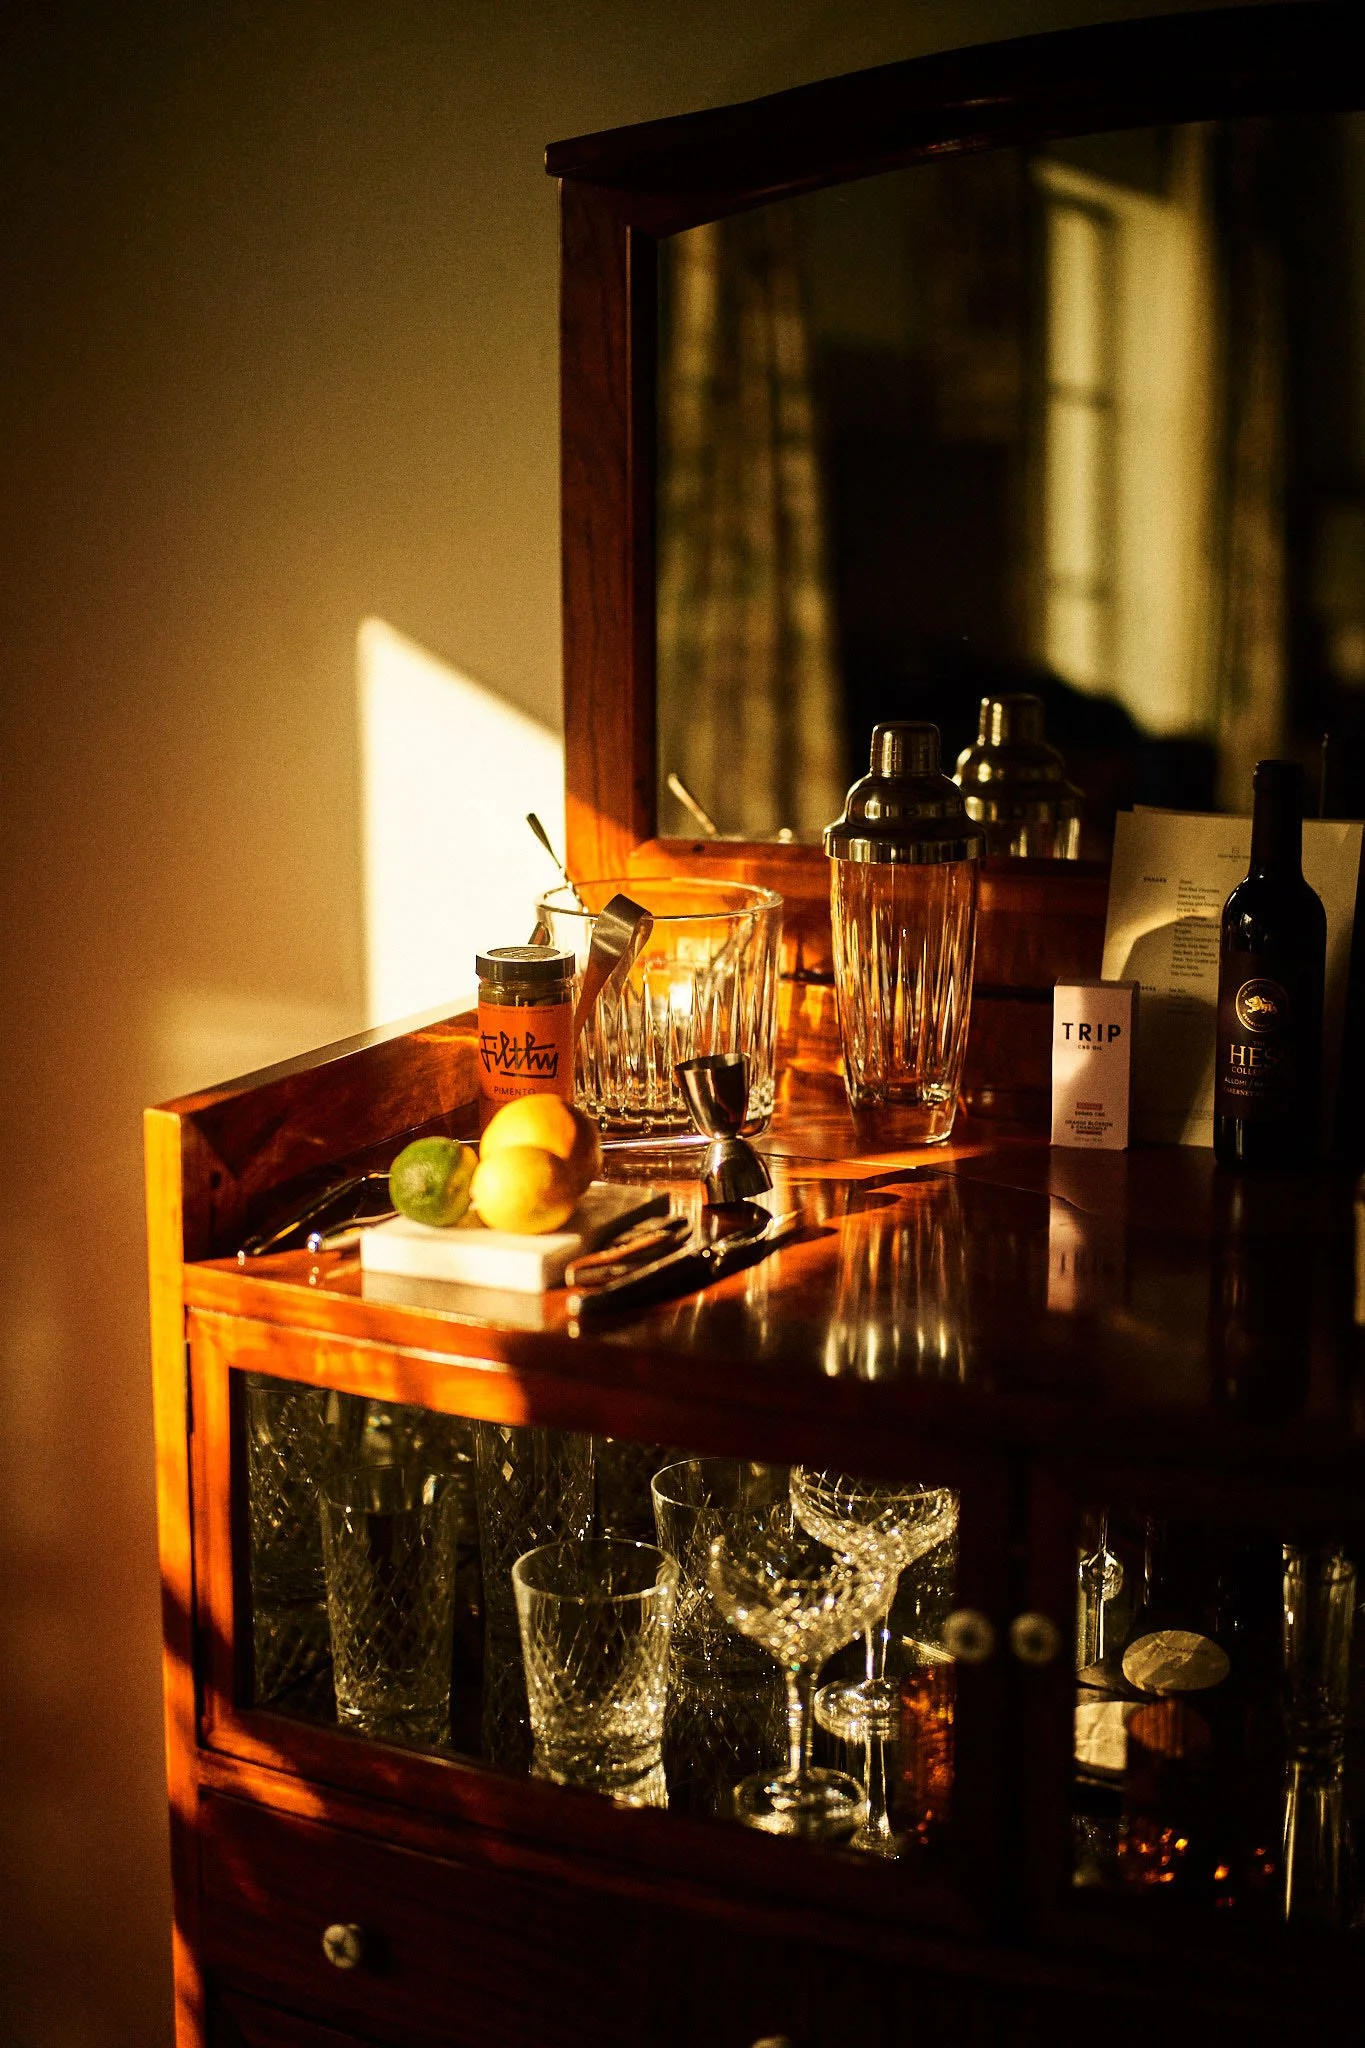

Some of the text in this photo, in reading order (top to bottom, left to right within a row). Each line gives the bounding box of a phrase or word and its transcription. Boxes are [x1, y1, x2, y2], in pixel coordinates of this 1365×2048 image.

[1062, 1023, 1121, 1043] TRIP
[480, 1030, 559, 1079] Filthy
[494, 1086, 536, 1097] PIMENTO
